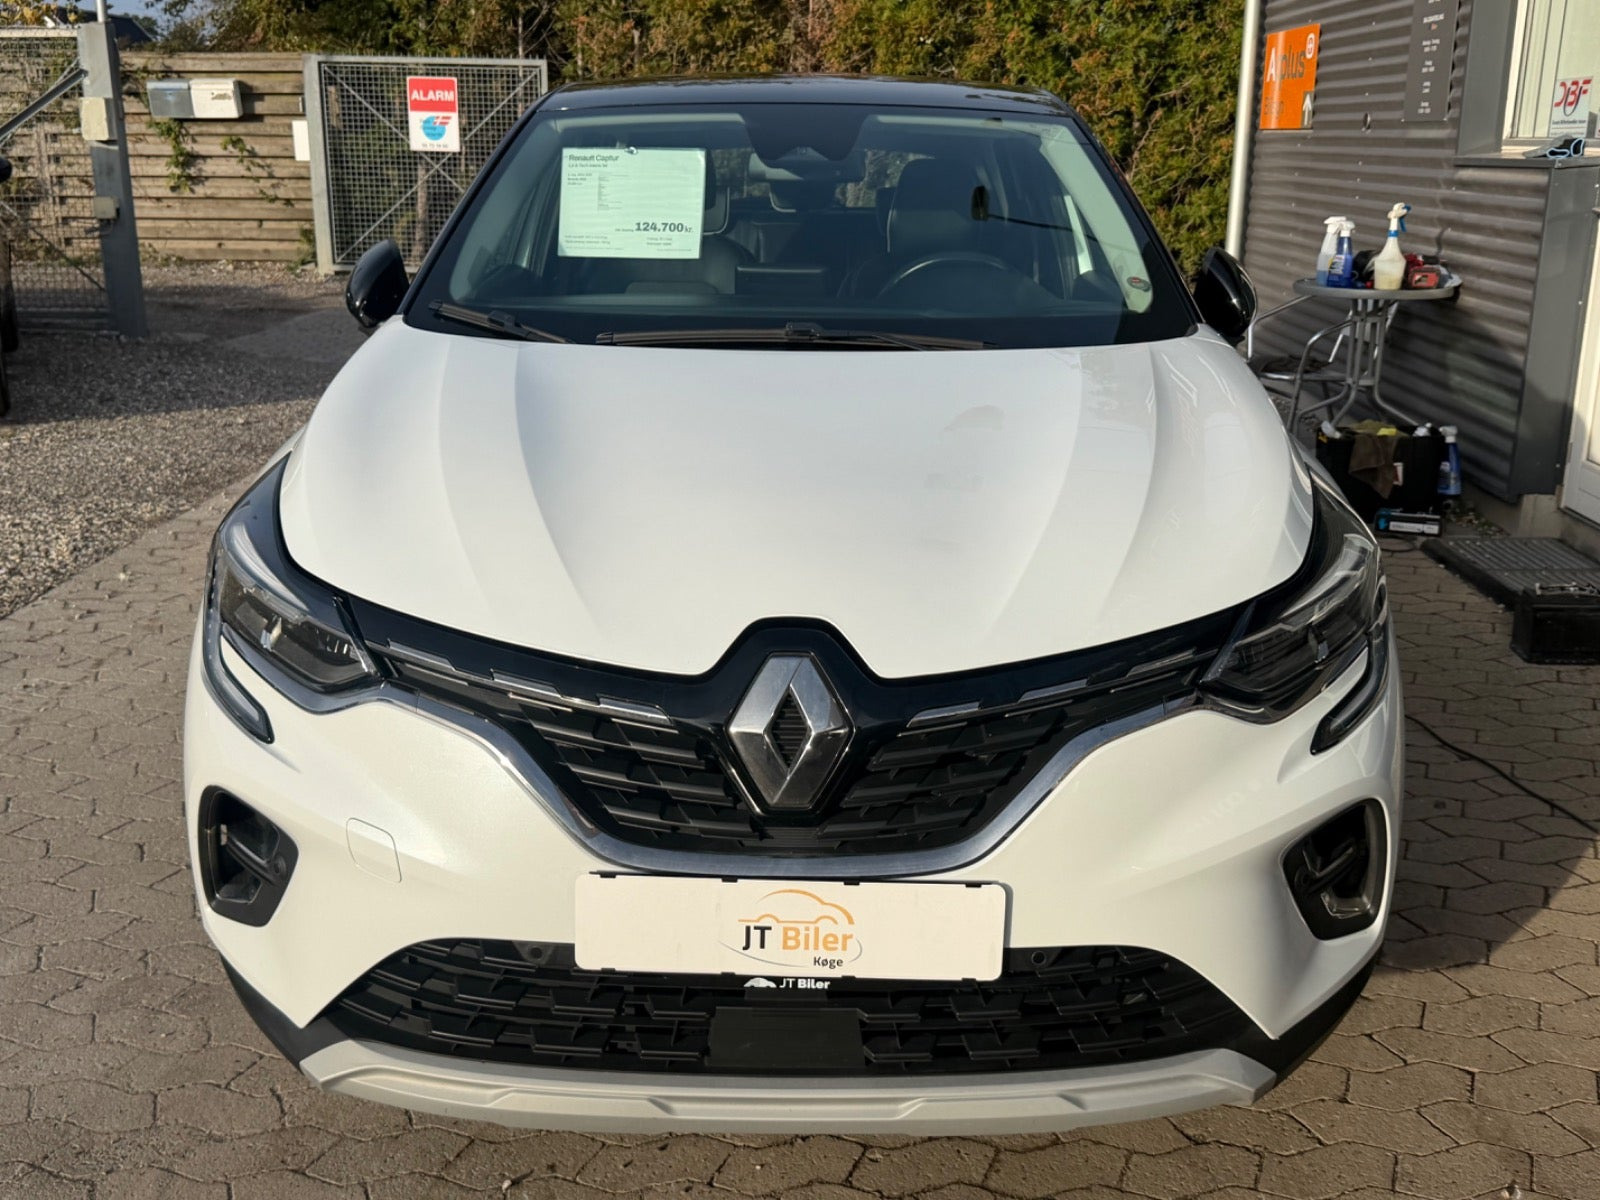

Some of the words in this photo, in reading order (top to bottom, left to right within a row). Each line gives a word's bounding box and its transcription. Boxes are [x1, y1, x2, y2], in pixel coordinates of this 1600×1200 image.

[411, 89, 455, 102] ALARM
[596, 154, 619, 162] Captur
[635, 222, 684, 232] 124.700
[742, 925, 772, 951] JT
[782, 926, 853, 952] Biler
[813, 956, 844, 970] Køge
[779, 978, 796, 989] JT
[797, 978, 830, 990] Biler
